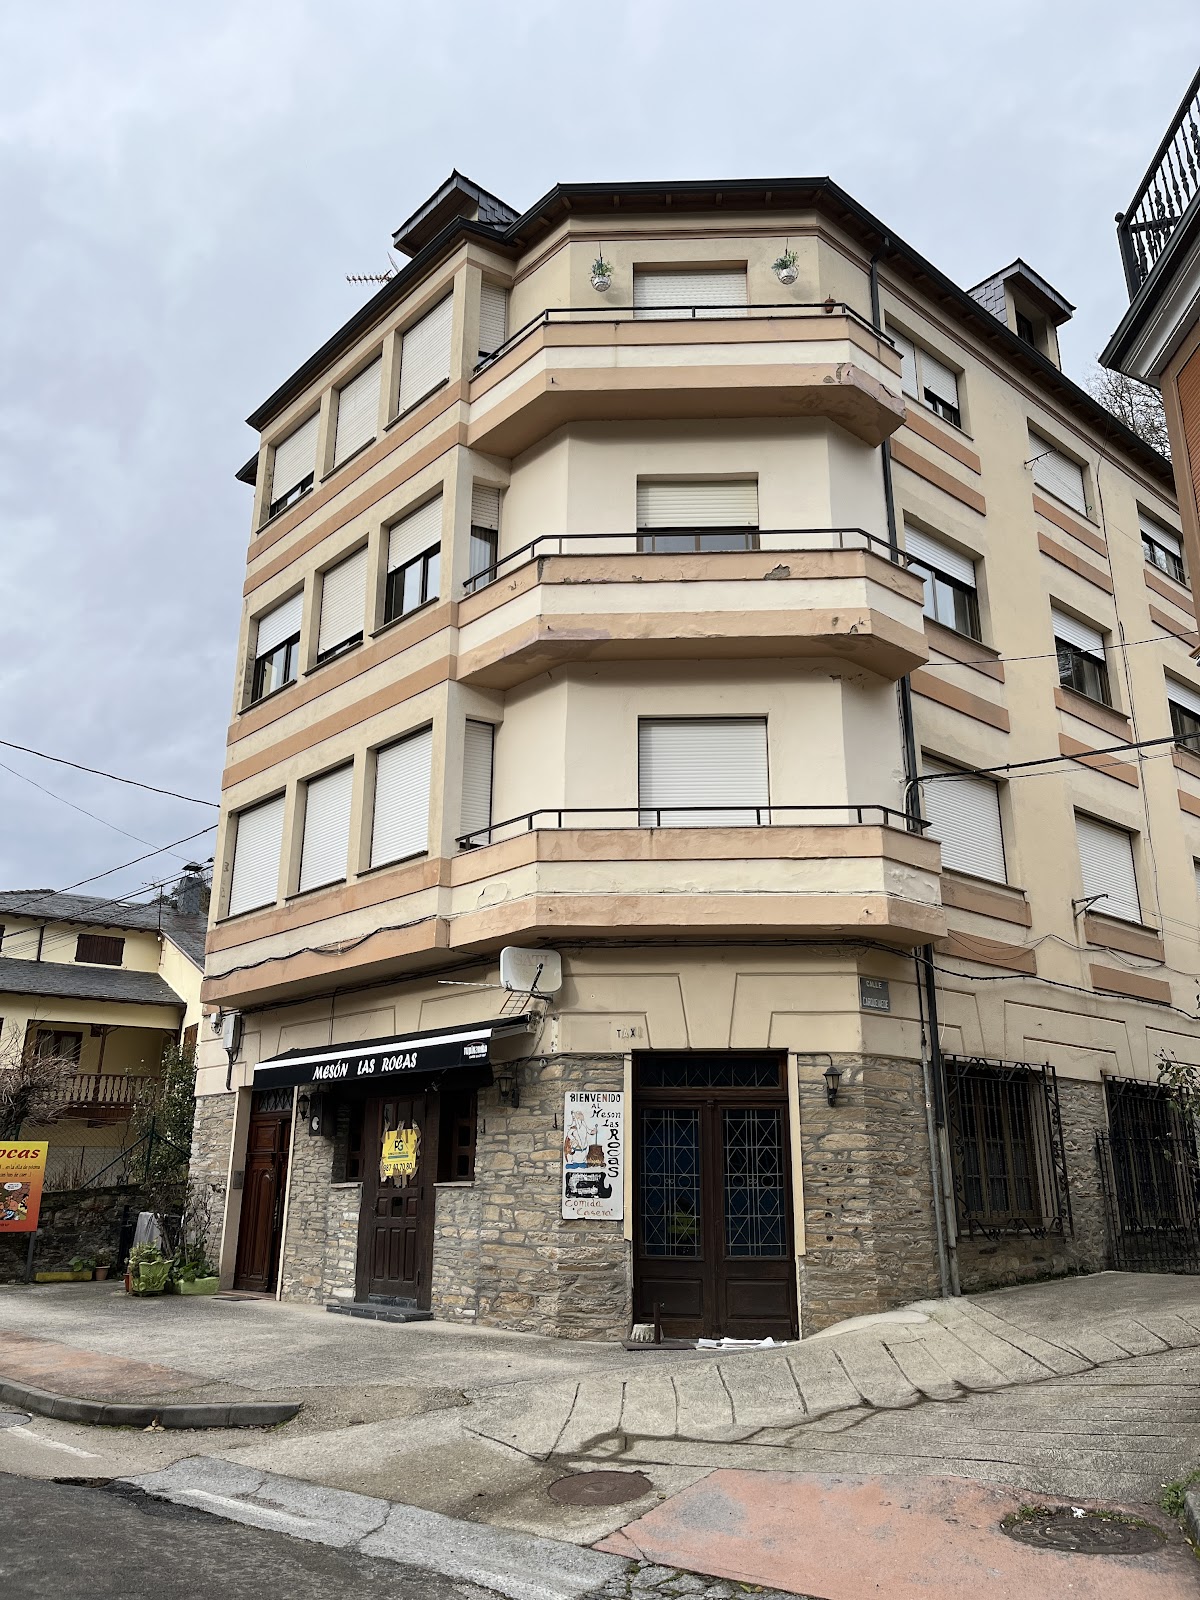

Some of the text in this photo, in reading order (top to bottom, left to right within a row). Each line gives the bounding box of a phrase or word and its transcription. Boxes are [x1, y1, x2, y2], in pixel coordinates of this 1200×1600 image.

[866, 980, 882, 989] CALLE
[312, 1052, 418, 1080] MESÓN LAS ROCAS
[569, 1093, 621, 1103] BIENVENIDO
[602, 1118, 619, 1128] Las
[564, 1199, 604, 1208] Comida
[576, 1207, 614, 1217] Casera
